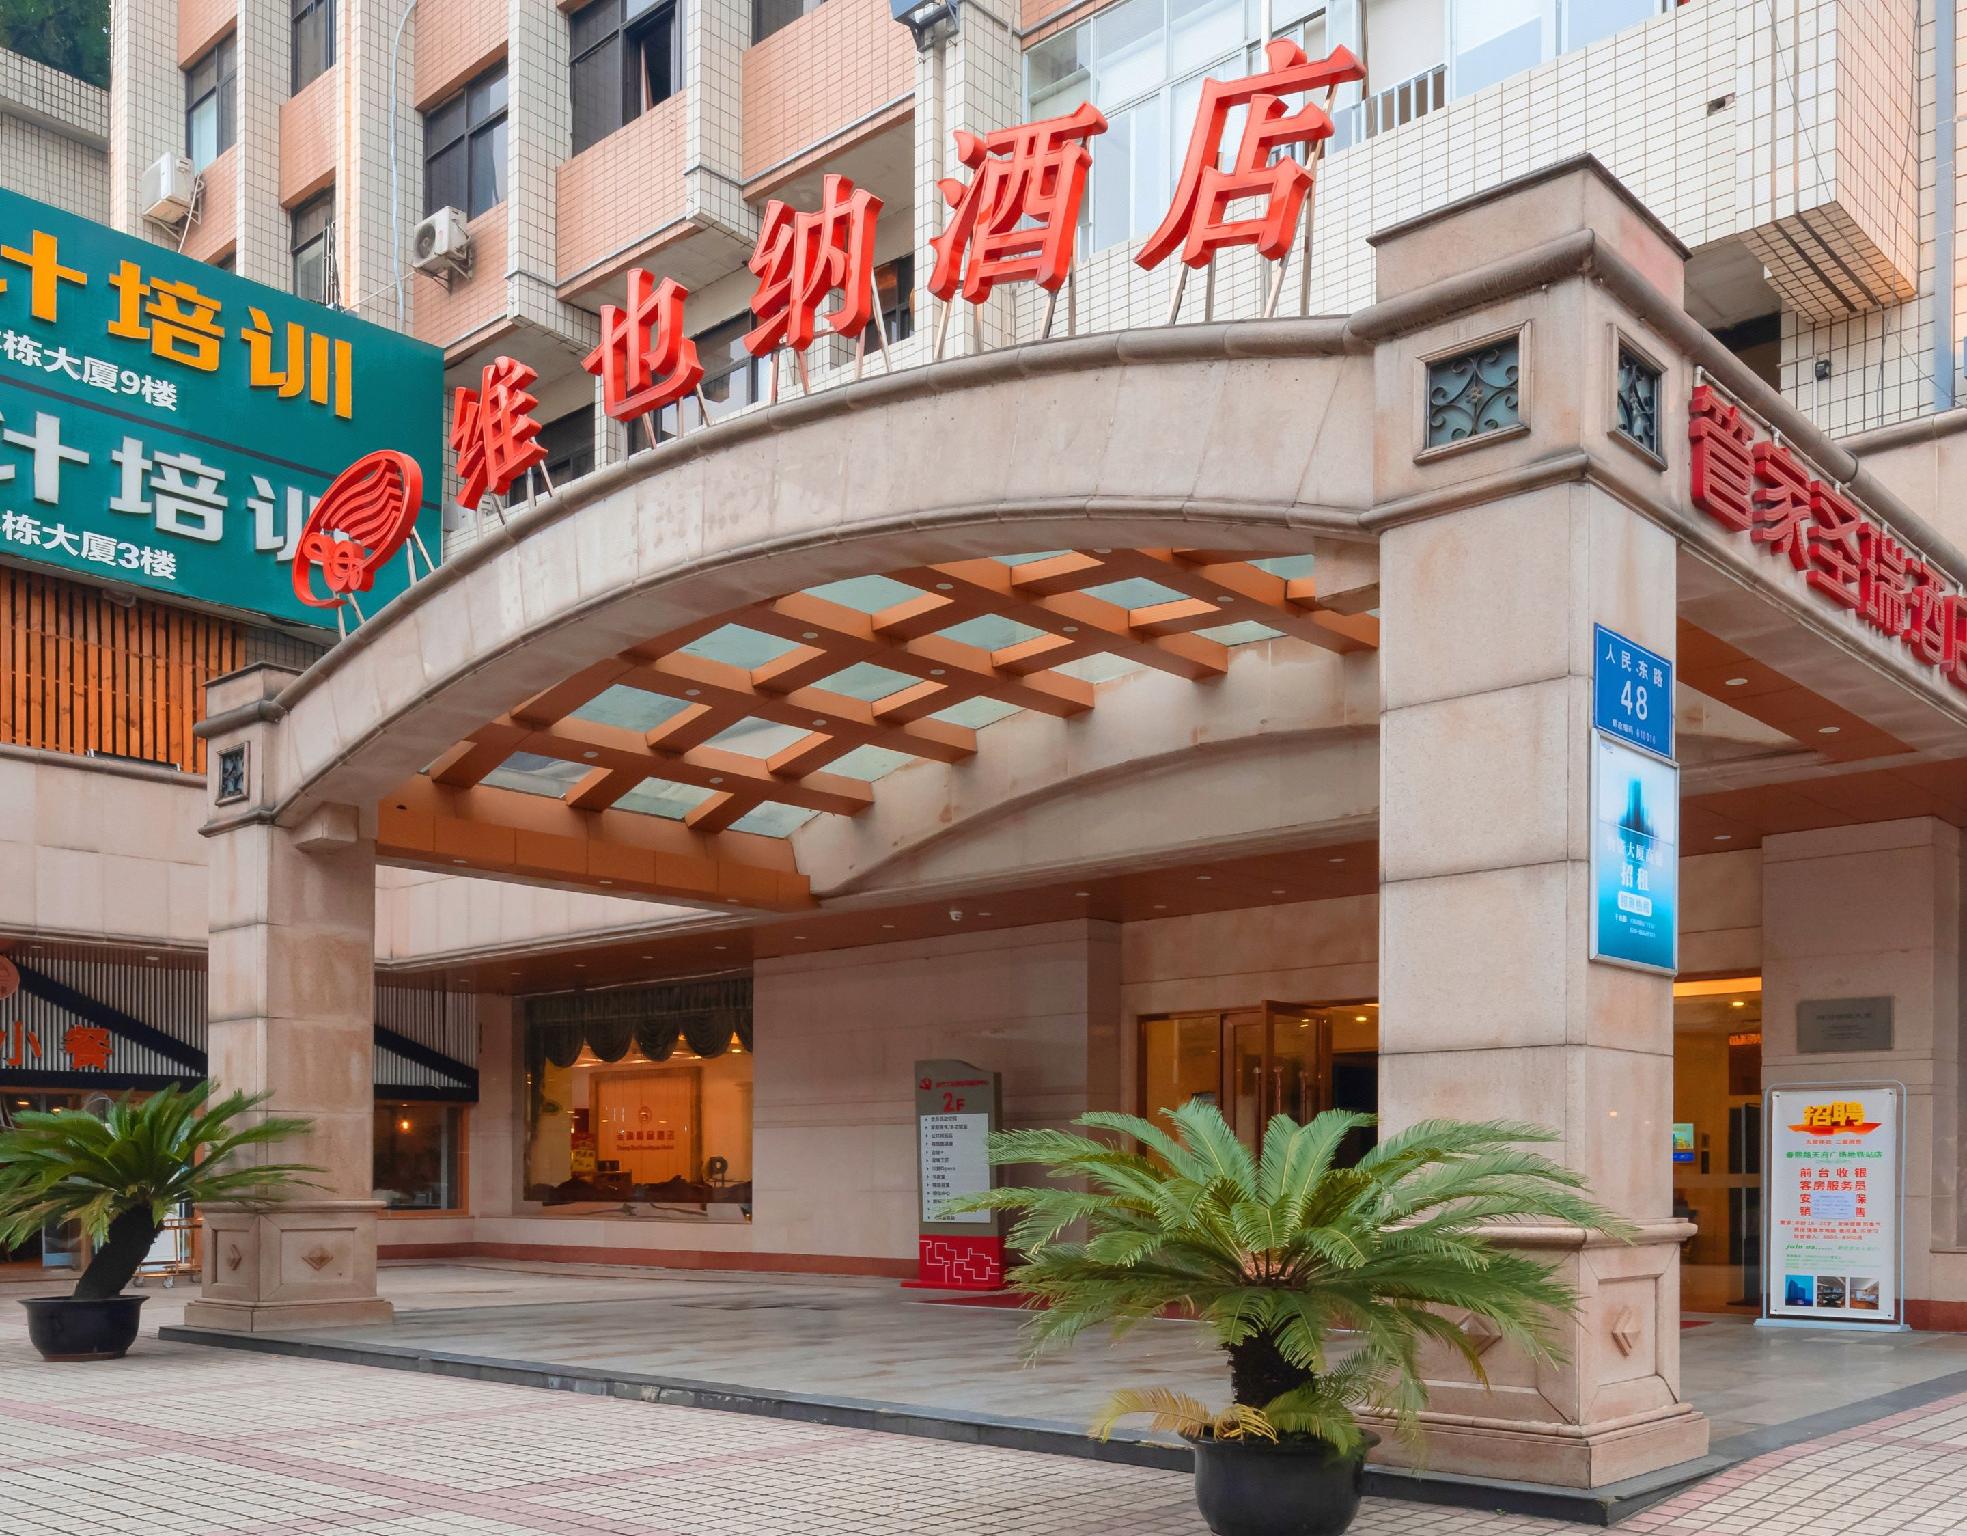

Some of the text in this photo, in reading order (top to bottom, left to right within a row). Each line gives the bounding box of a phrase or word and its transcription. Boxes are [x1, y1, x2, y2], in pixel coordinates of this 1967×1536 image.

[451, 38, 1366, 509] 维也纳酒店
[0, 330, 177, 411] 栋大厦9楼
[0, 510, 177, 580] 栋大厦3楼
[1605, 643, 1663, 689] 人民东路
[1620, 680, 1648, 721] 48
[943, 1092, 966, 1113] 2F
[1803, 1101, 1866, 1127] 招聘
[1800, 1167, 1867, 1178] 前台收银
[1800, 1180, 1866, 1191] 客房服务员
